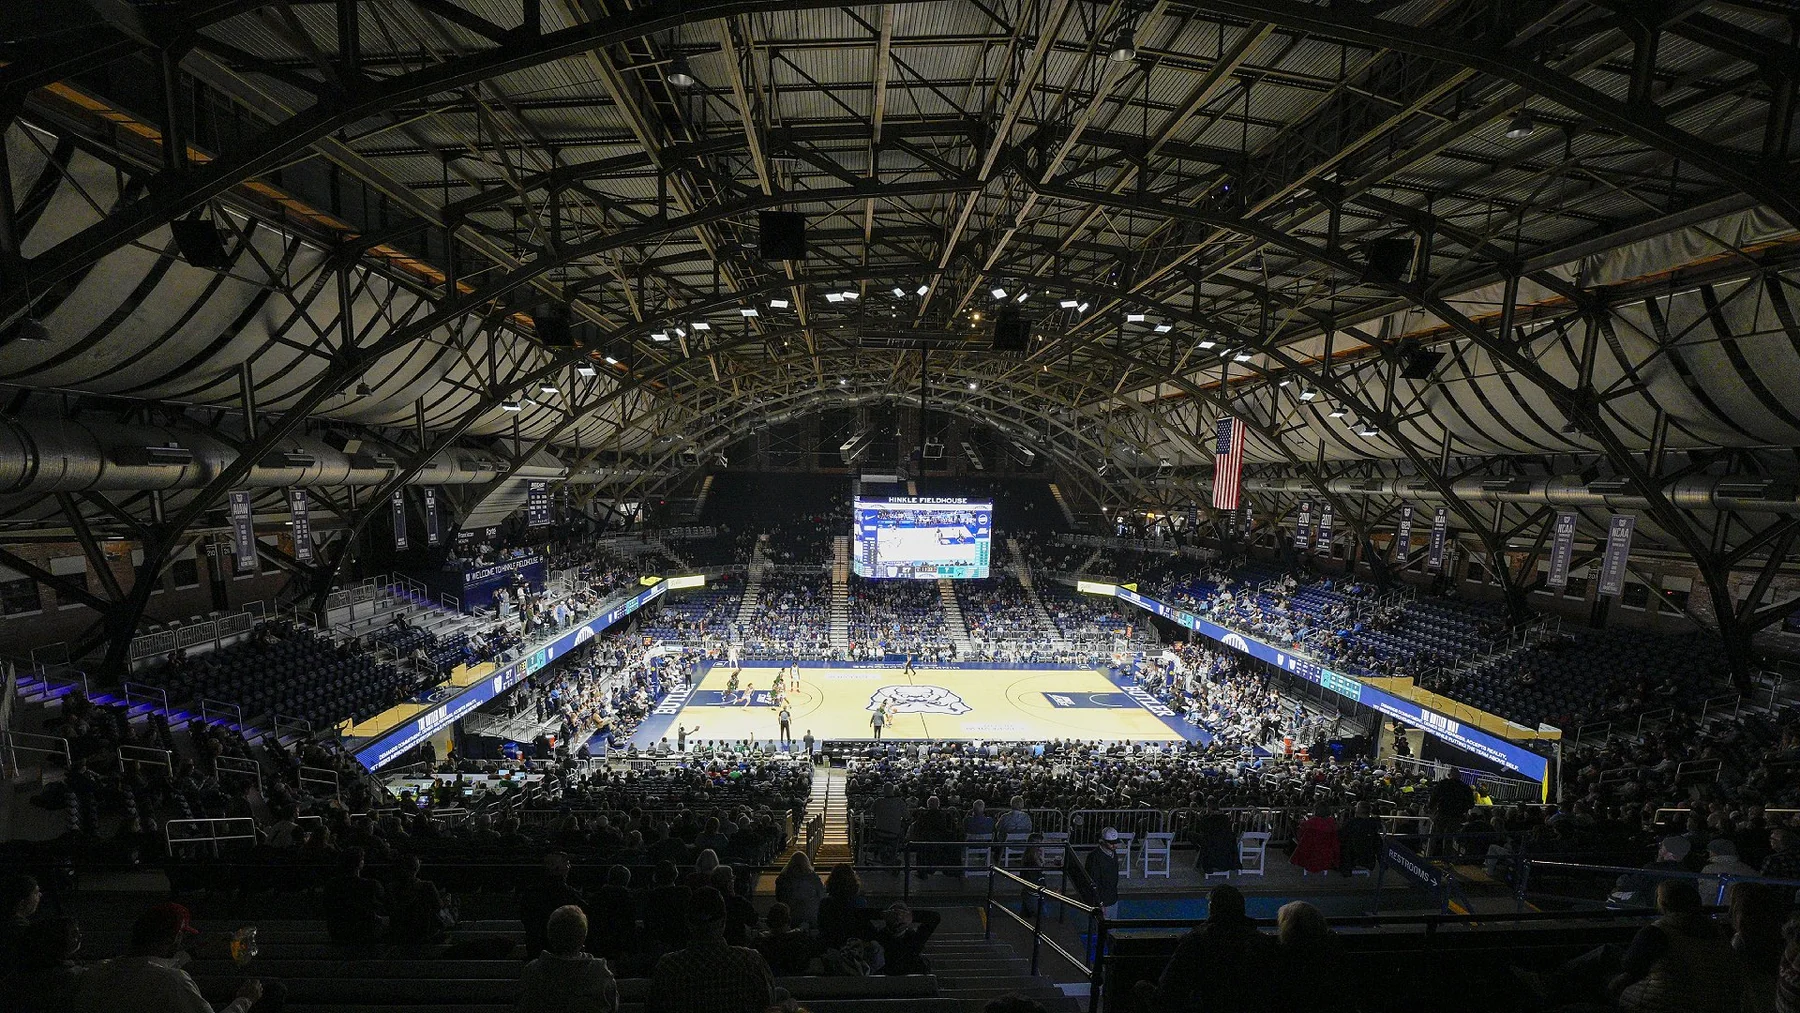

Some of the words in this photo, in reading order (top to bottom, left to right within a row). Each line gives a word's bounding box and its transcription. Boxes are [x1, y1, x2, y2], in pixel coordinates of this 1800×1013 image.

[1558, 524, 1573, 533] NCAA
[1612, 528, 1629, 538] NCAA
[471, 567, 494, 580] WELCOME
[495, 566, 502, 574] TO
[516, 556, 538, 567] FIELDHOUSE
[1121, 686, 1176, 718] BUTLER
[1389, 849, 1429, 882] RESTROOMS
